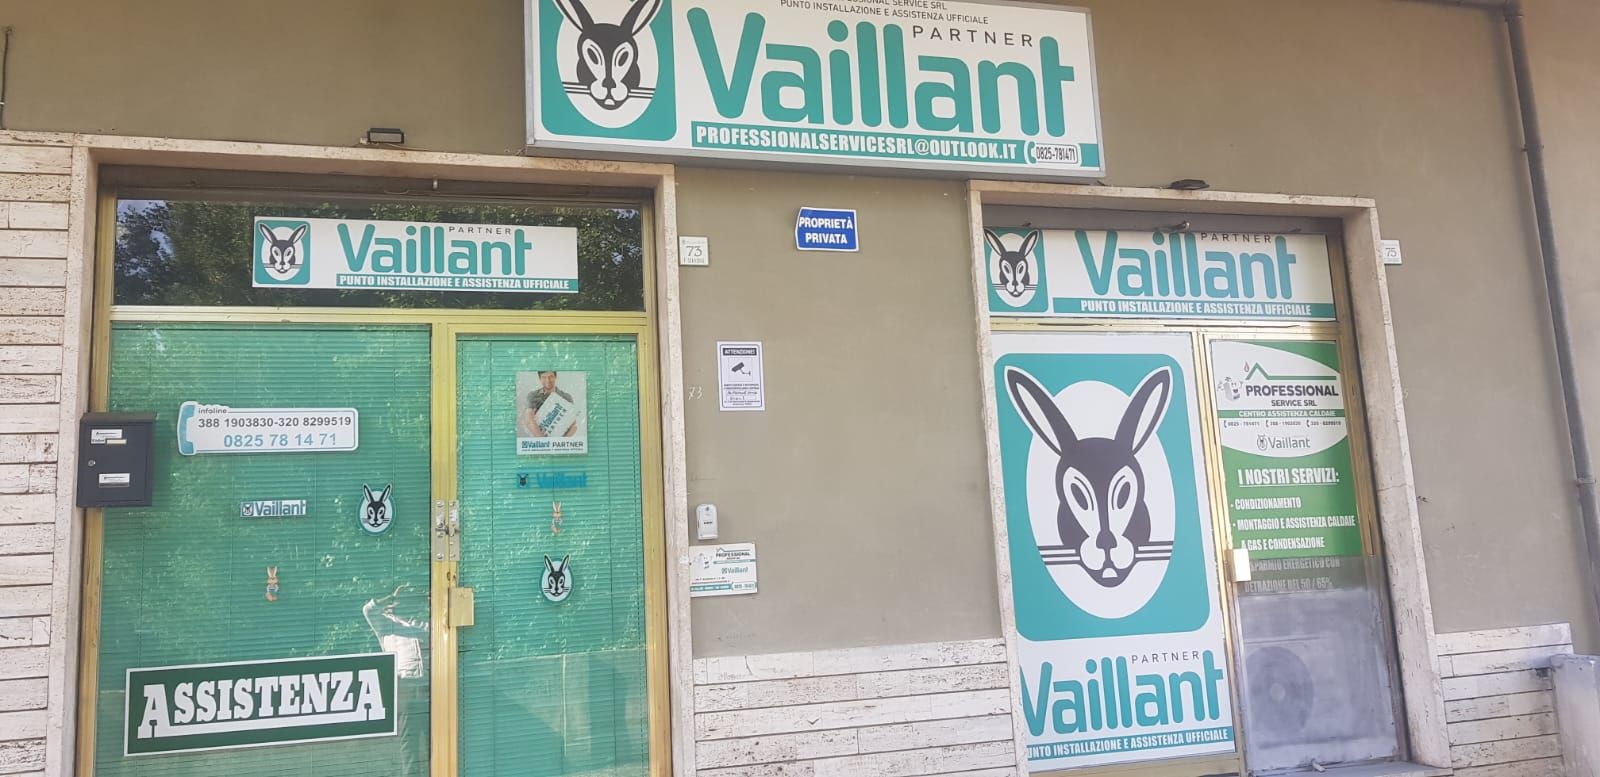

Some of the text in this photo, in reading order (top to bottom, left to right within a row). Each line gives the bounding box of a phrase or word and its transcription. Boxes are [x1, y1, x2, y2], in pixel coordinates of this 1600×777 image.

[780, 0, 989, 24] PUNTO INSTALLAZIONE E ASSISTENZA UFFICIALE
[892, 0, 929, 8] SERVICE
[931, 1, 947, 10] SRL
[912, 25, 1033, 47] PARTNER
[687, 7, 1075, 137] Vaillant
[695, 125, 1017, 161] PROFESSIONALSERVICESRL@OUTLOOK.IT
[1035, 146, 1076, 161] 0825-781471
[799, 216, 853, 229] PROPRIETÀ
[448, 226, 512, 236] PARTNER
[1201, 231, 1272, 243] PARTNER
[805, 233, 848, 244] PRIVATA
[337, 223, 532, 276] Vaillant
[686, 245, 703, 256] 73
[1385, 247, 1397, 258] 75
[1074, 229, 1296, 299] Vaillant
[340, 275, 569, 289] PUNTO INSTALLAZIONE E ASSISTENZA UFFICIALE
[1081, 300, 1311, 316] PUNTO INSTALLAZIONE E ASSISTENZA UFFICIALE
[1245, 384, 1339, 396] PROFESSIONAL
[198, 416, 351, 428] 388 1903830-320 8299519
[224, 433, 337, 448] 0825 78 14 71
[1269, 437, 1311, 449] Vaillant
[1238, 467, 1340, 485] I NOSTRI SERVIZI:
[255, 500, 306, 516] Vaillant
[1234, 497, 1302, 510] CONDIZIONAMENTO
[1237, 515, 1356, 531] MONTAGGIO E ASSISTENZA CALDAIE
[1241, 537, 1325, 551] A GAS E CONDENSAZIONE
[728, 566, 749, 574] Vaillant
[1131, 651, 1200, 664] PARTNER
[1019, 650, 1223, 737] Vaillant
[137, 669, 386, 739] ASSISTENZA
[1053, 738, 1122, 756] INSTALLAZIONE
[1123, 738, 1129, 749] E
[1131, 734, 1184, 749] ASSISTENZA
[1186, 729, 1228, 743] UFFICIALE
